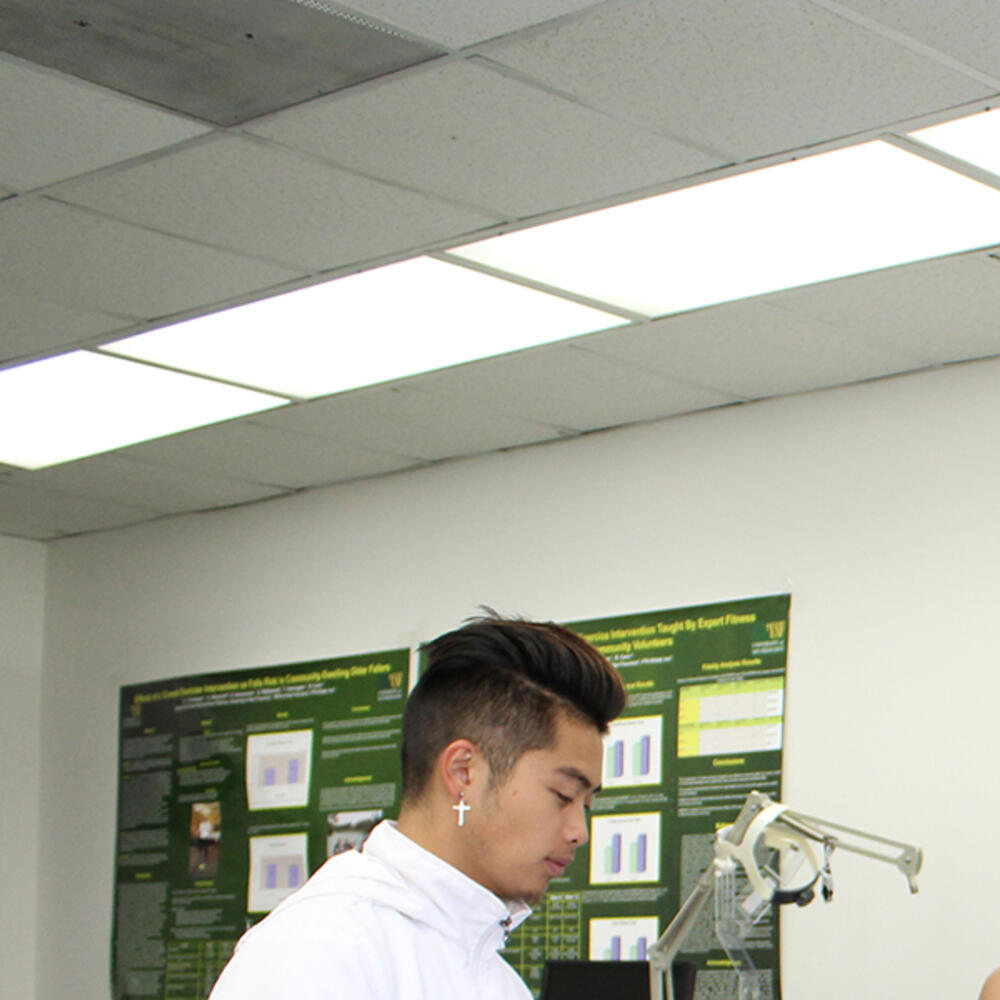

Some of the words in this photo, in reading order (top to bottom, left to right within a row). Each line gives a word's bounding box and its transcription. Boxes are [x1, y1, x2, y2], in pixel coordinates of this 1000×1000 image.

[610, 625, 657, 641] Intervention
[657, 621, 684, 634] Taught
[684, 618, 697, 632] By
[698, 615, 724, 630] Expert
[724, 612, 756, 626] Fitness
